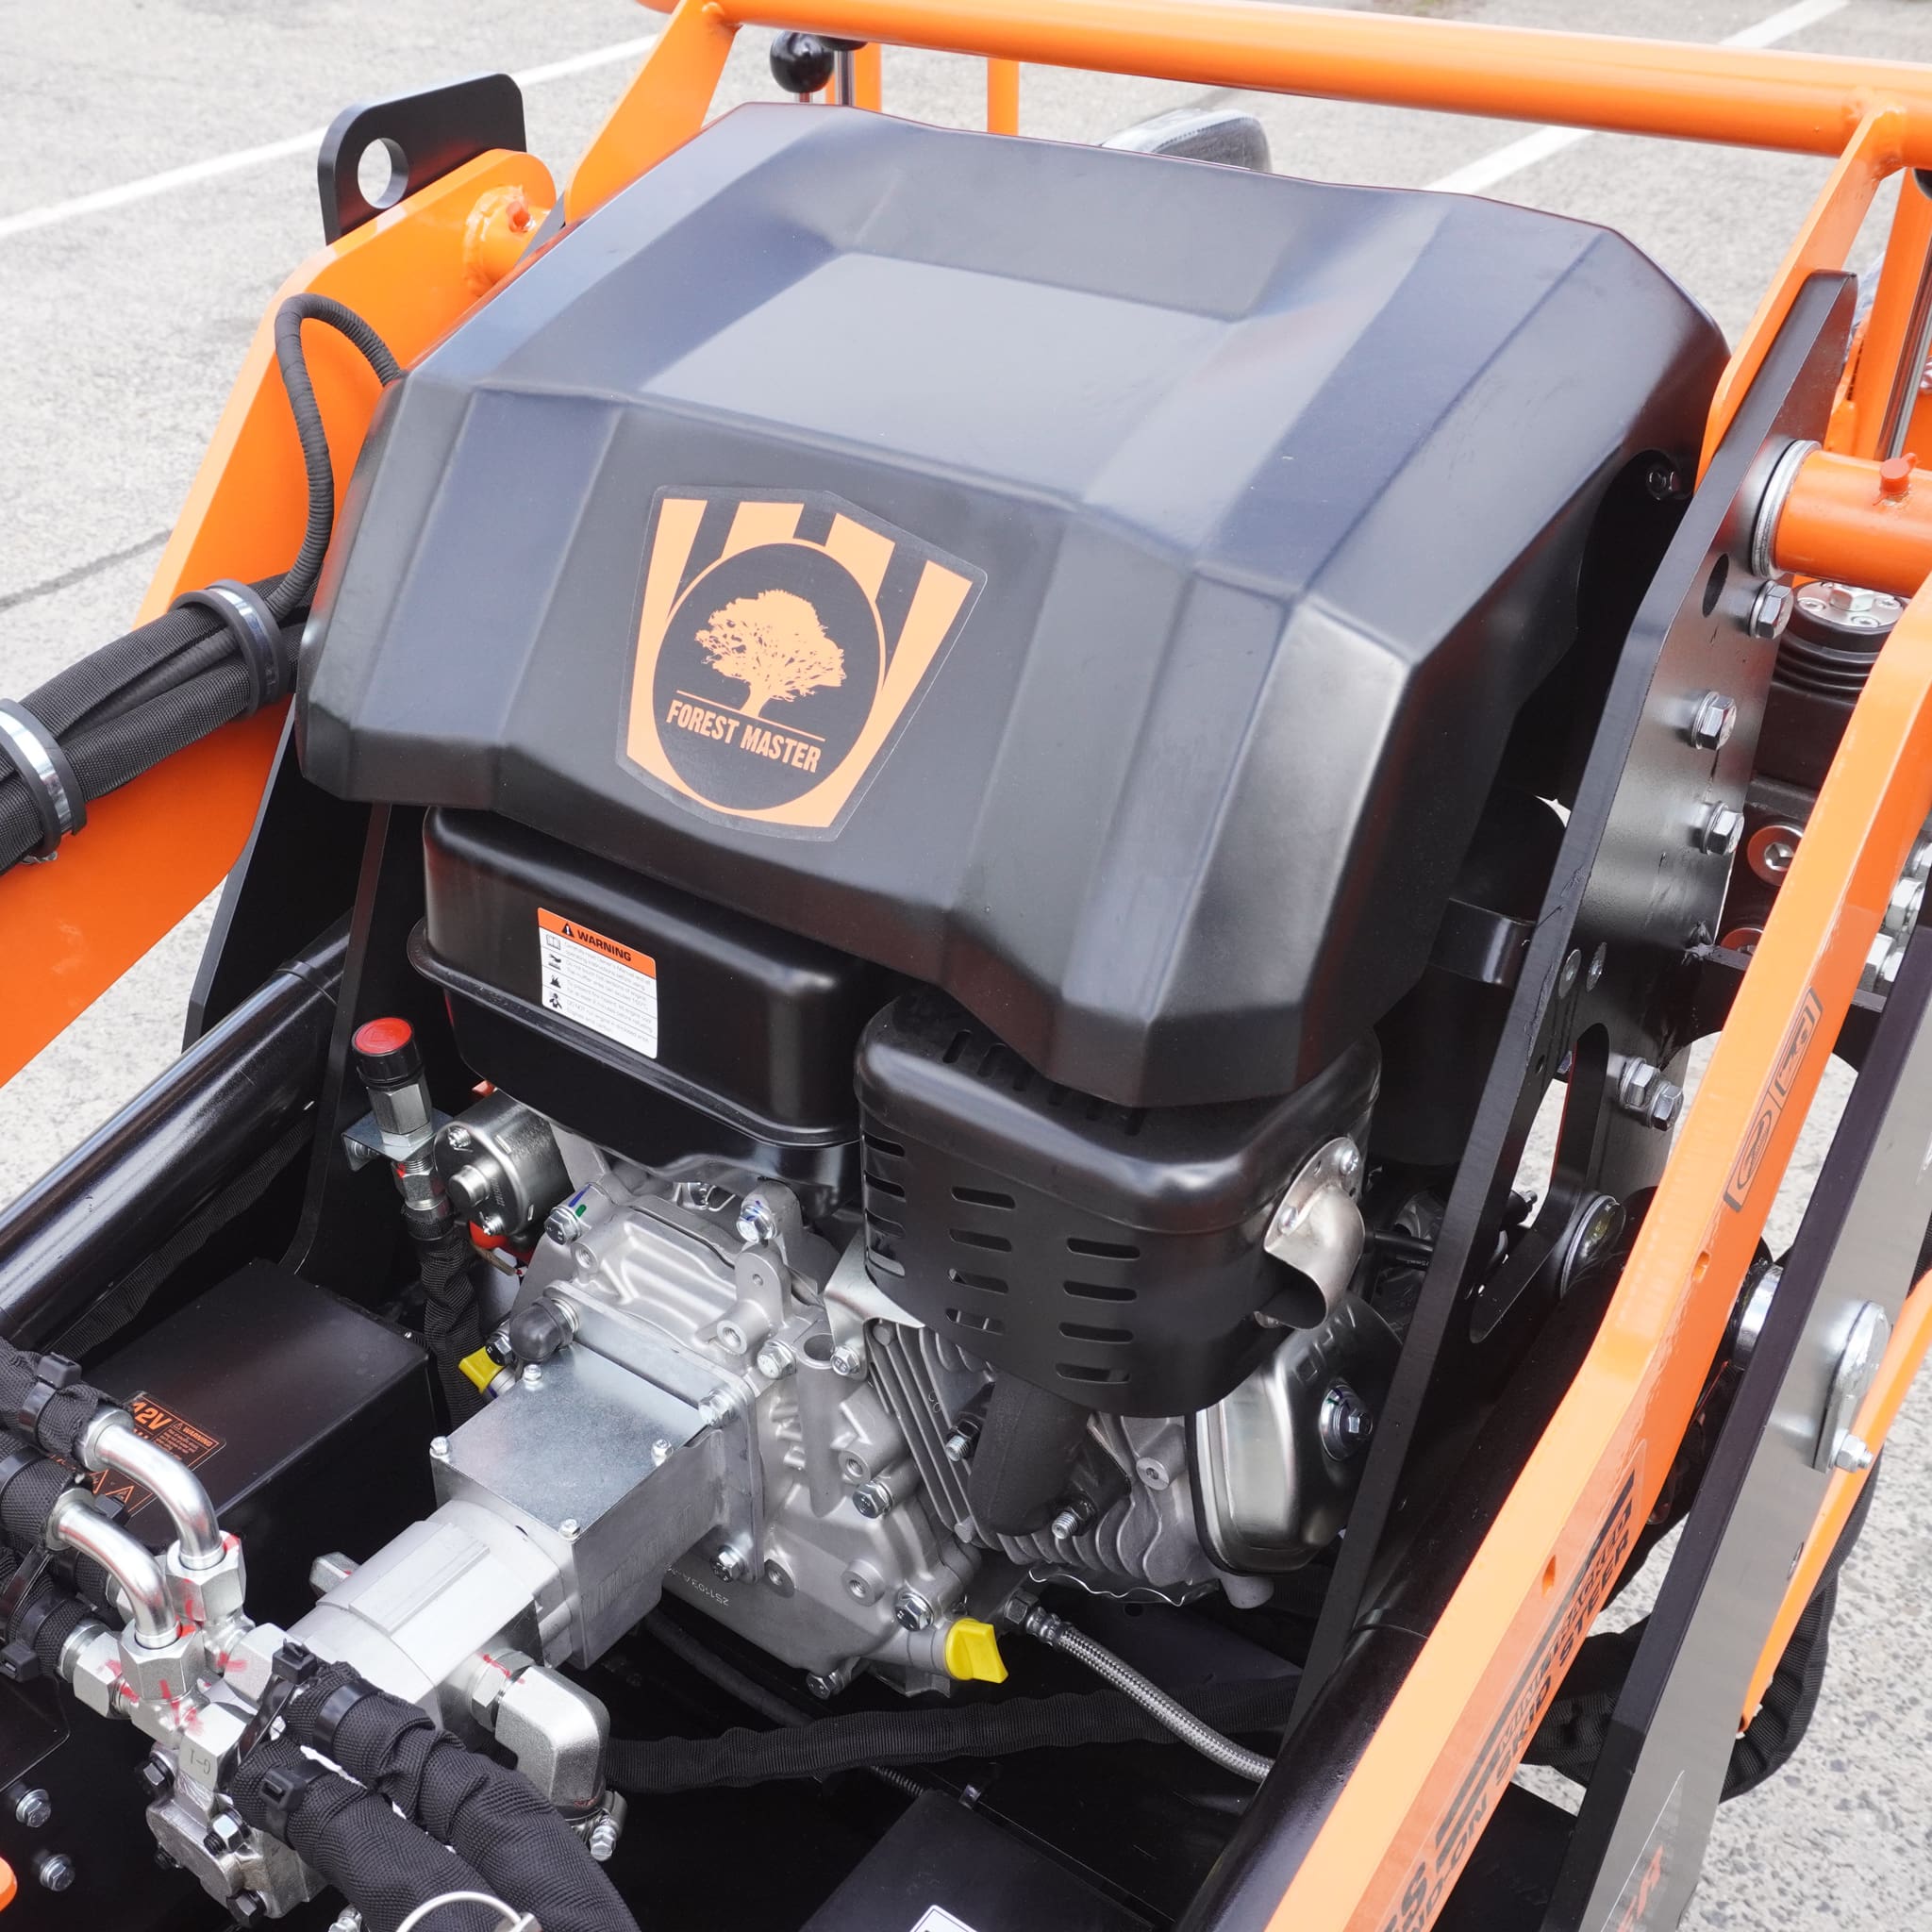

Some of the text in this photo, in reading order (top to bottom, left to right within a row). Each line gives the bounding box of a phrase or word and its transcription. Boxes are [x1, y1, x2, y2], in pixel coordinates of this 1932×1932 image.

[665, 699, 822, 773] FOREST MASTER
[576, 929, 632, 962] WARNING
[1558, 1527, 1630, 1668] STEER
